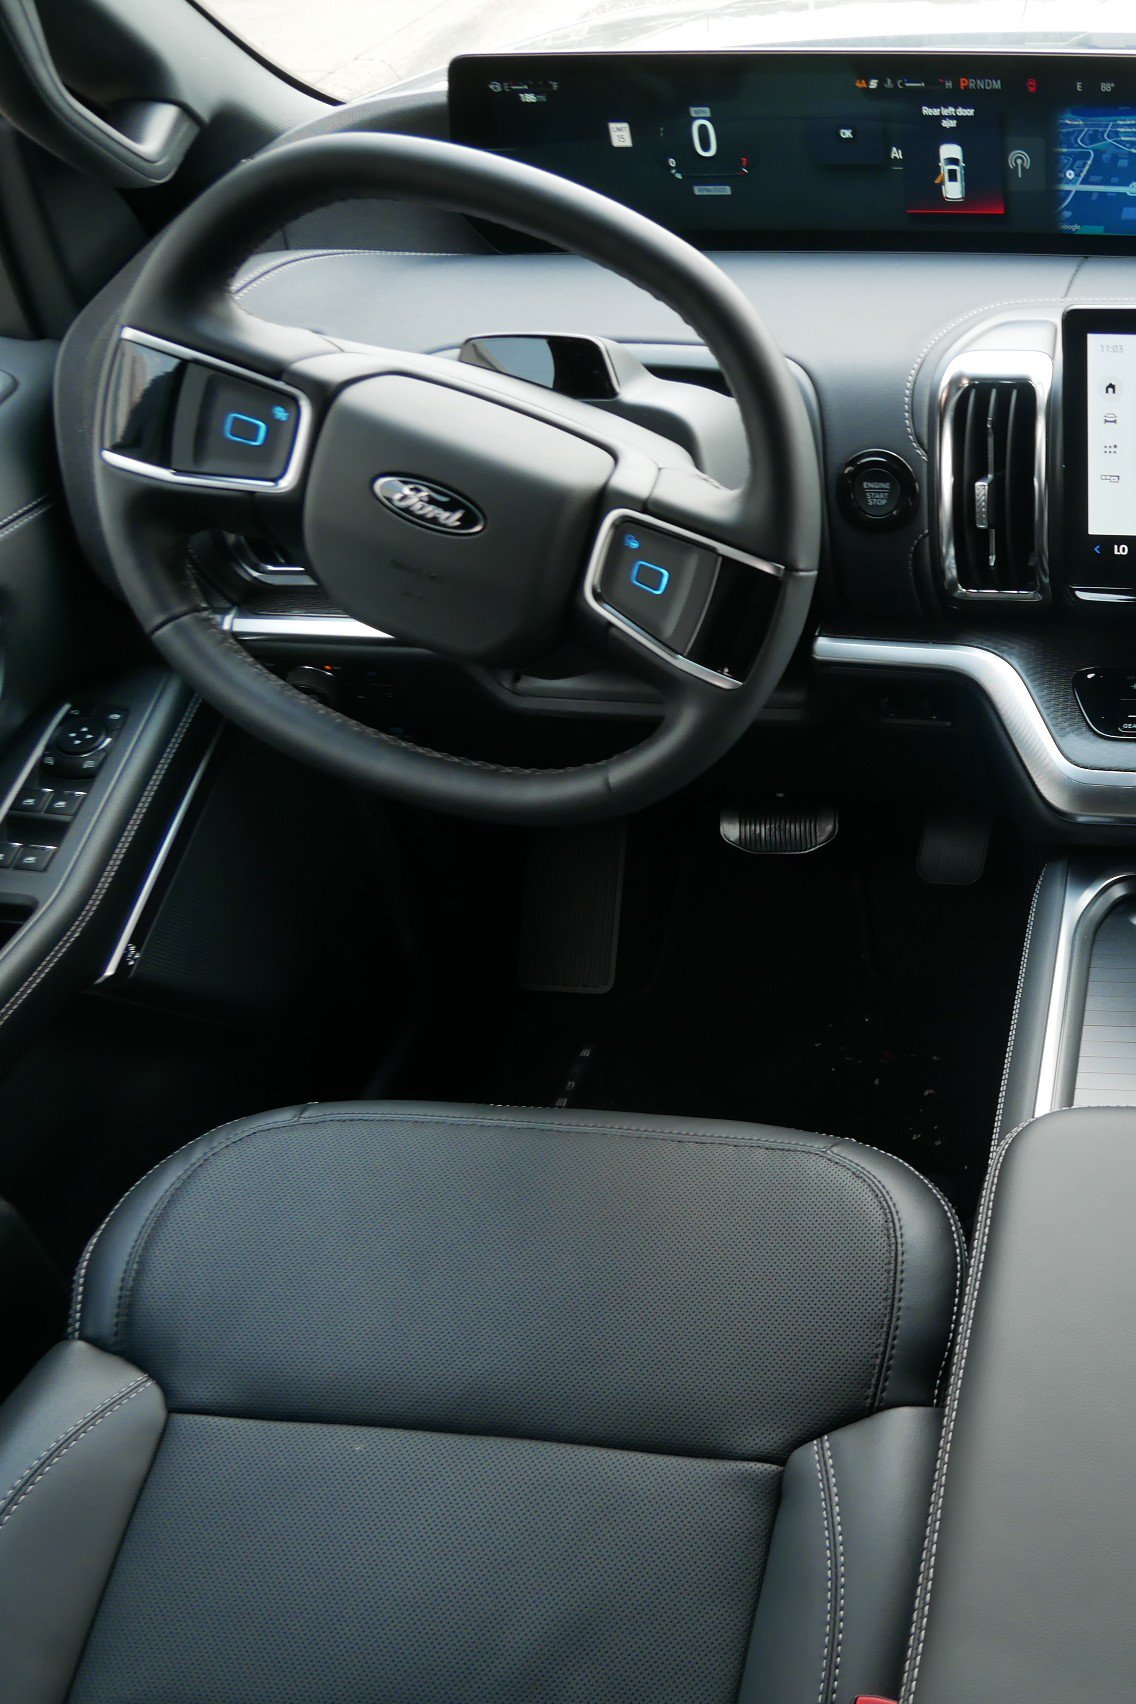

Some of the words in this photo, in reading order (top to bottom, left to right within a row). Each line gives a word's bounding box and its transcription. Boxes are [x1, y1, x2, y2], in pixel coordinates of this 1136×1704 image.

[921, 106, 941, 116] Rear
[941, 106, 956, 116] left
[956, 106, 975, 117] door
[941, 119, 958, 129] ajar
[691, 118, 718, 158] 0
[839, 129, 854, 139] OK
[1100, 344, 1124, 353] 11:03
[863, 481, 891, 489] ENGINE
[392, 484, 466, 527] Ford
[1113, 544, 1129, 555] LO
